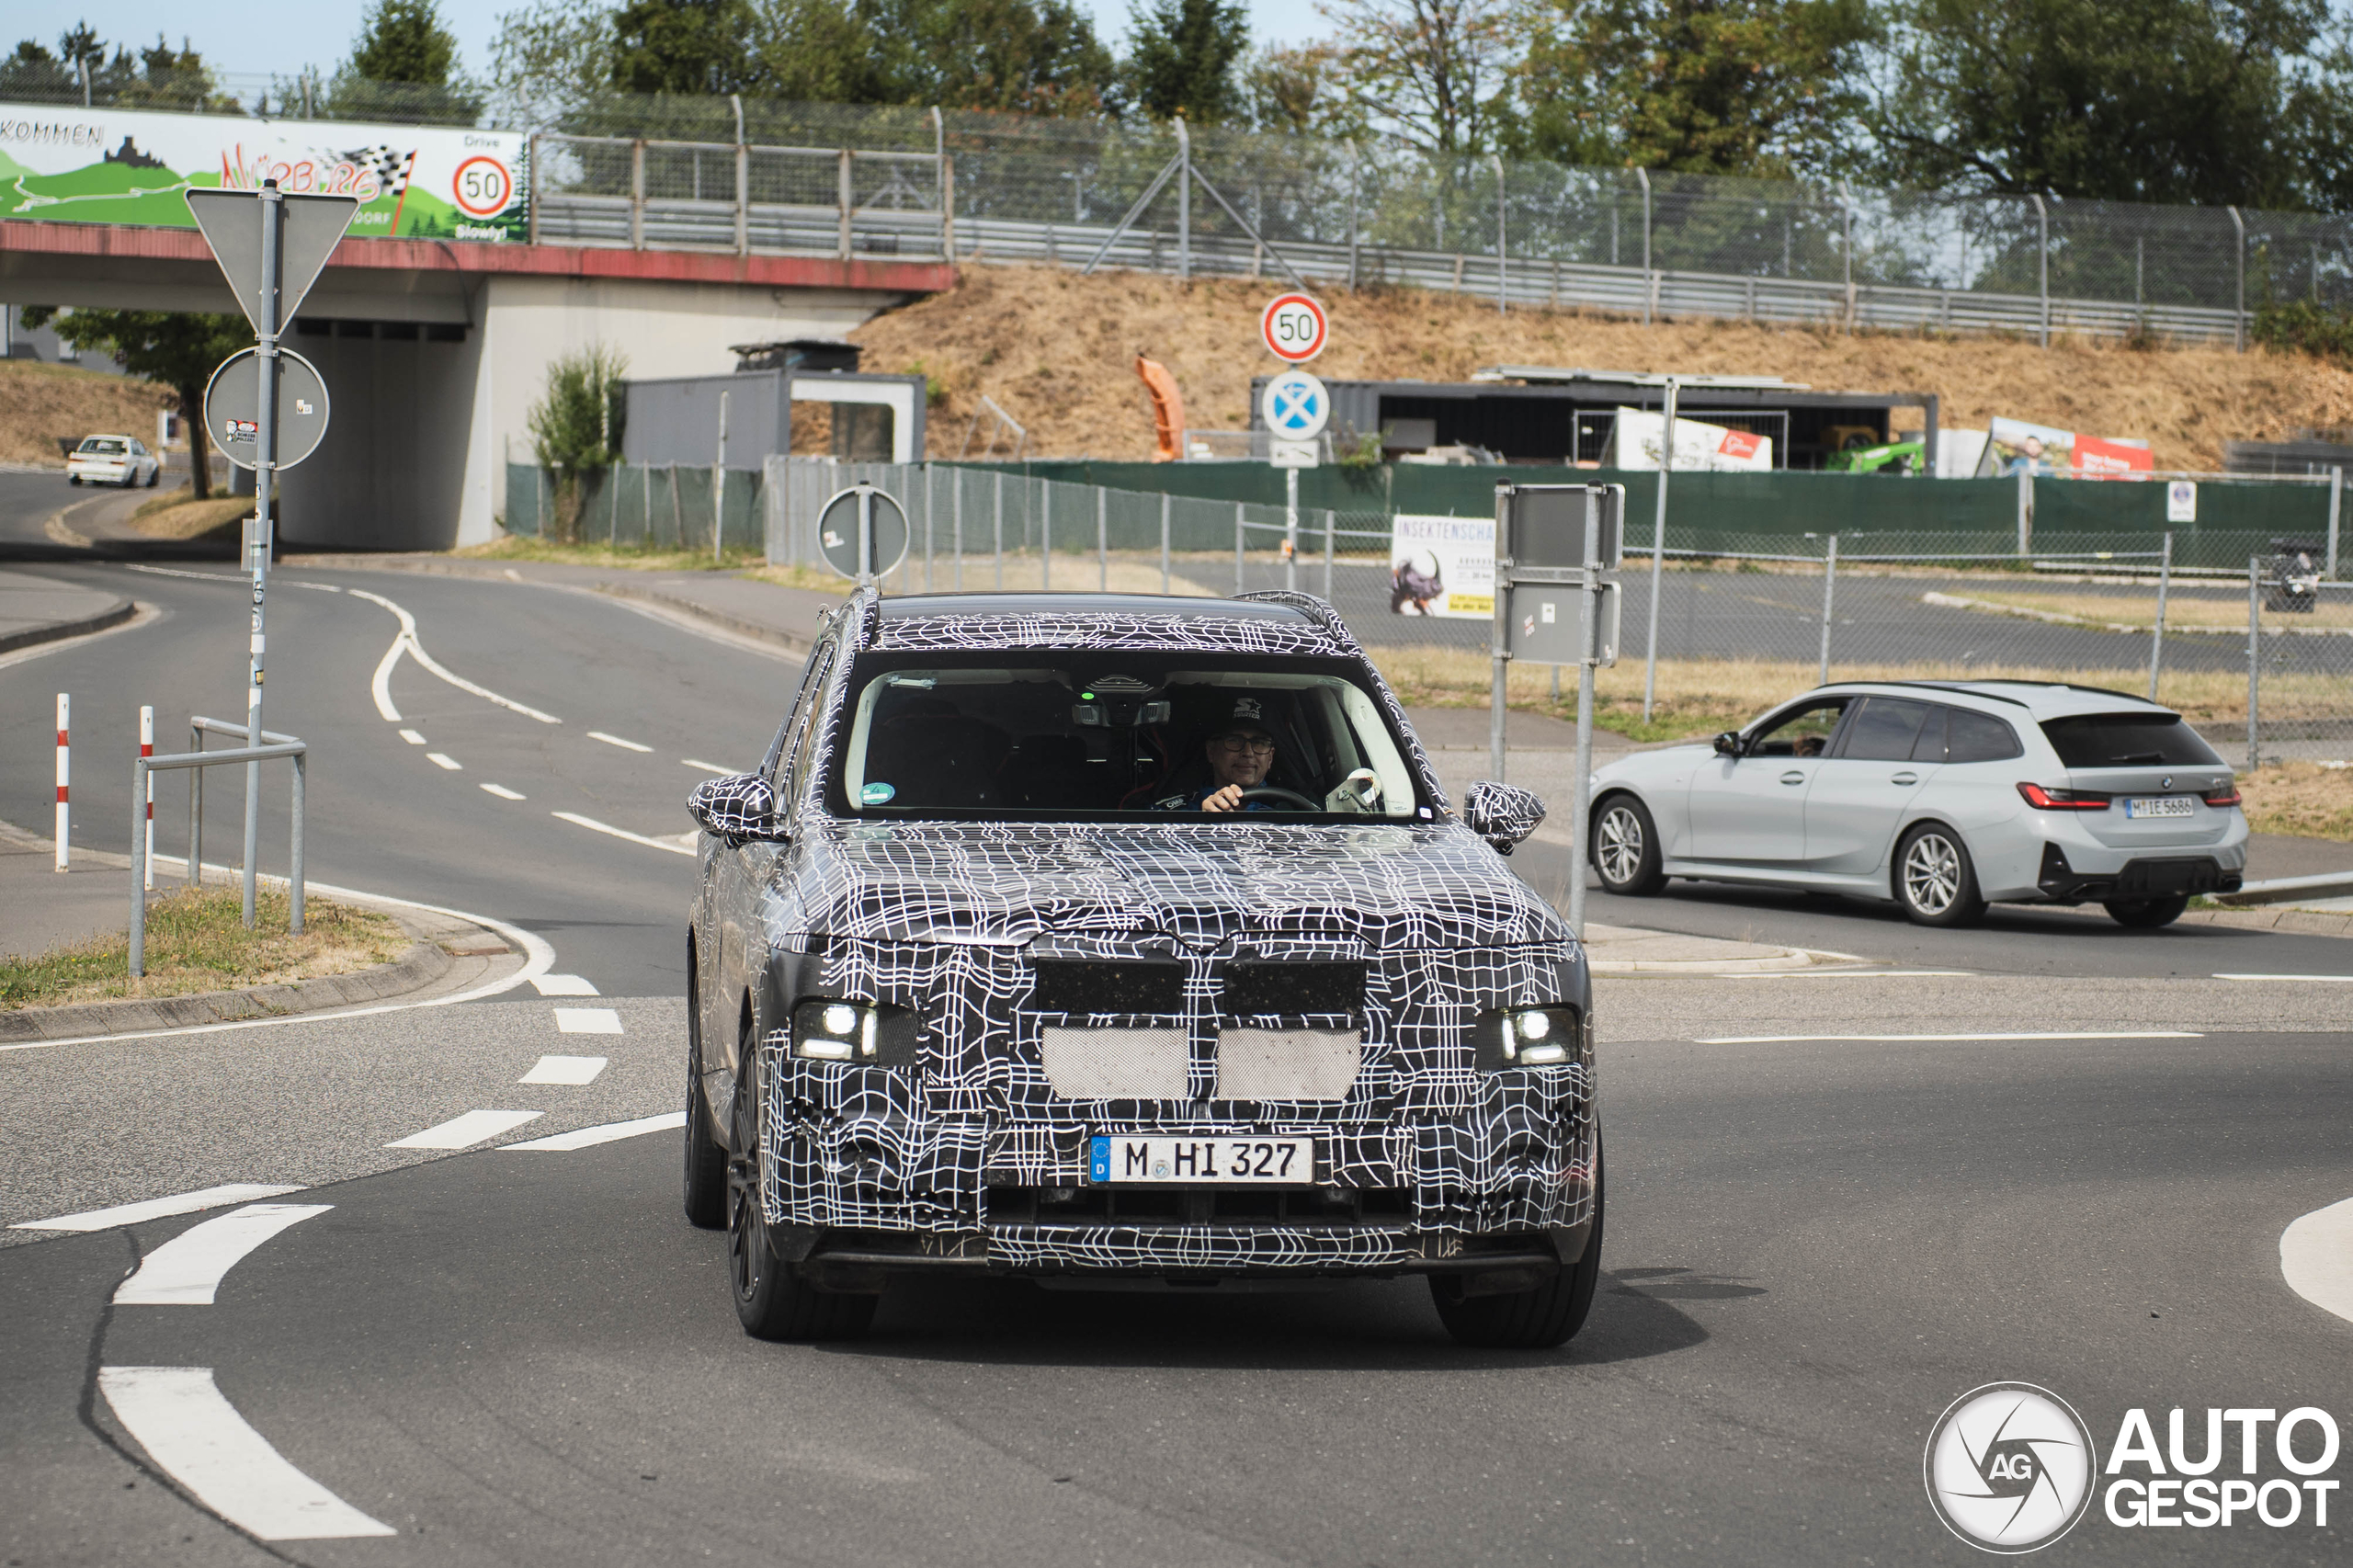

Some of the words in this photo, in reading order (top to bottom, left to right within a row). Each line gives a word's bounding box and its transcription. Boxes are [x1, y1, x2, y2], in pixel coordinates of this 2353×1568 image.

[1, 119, 103, 145] KOMMEN
[464, 135, 500, 147] Drive
[466, 171, 499, 199] 50
[455, 223, 507, 242] Slowly!
[1279, 313, 1313, 341] 50
[1233, 710, 1261, 720] STARTER
[2132, 801, 2142, 815] M
[2149, 801, 2162, 814] IE
[2164, 800, 2192, 814] 5686
[1096, 1164, 1106, 1176] D
[1125, 1142, 1148, 1176] M
[1175, 1142, 1219, 1176] HI
[1231, 1142, 1297, 1177] 327
